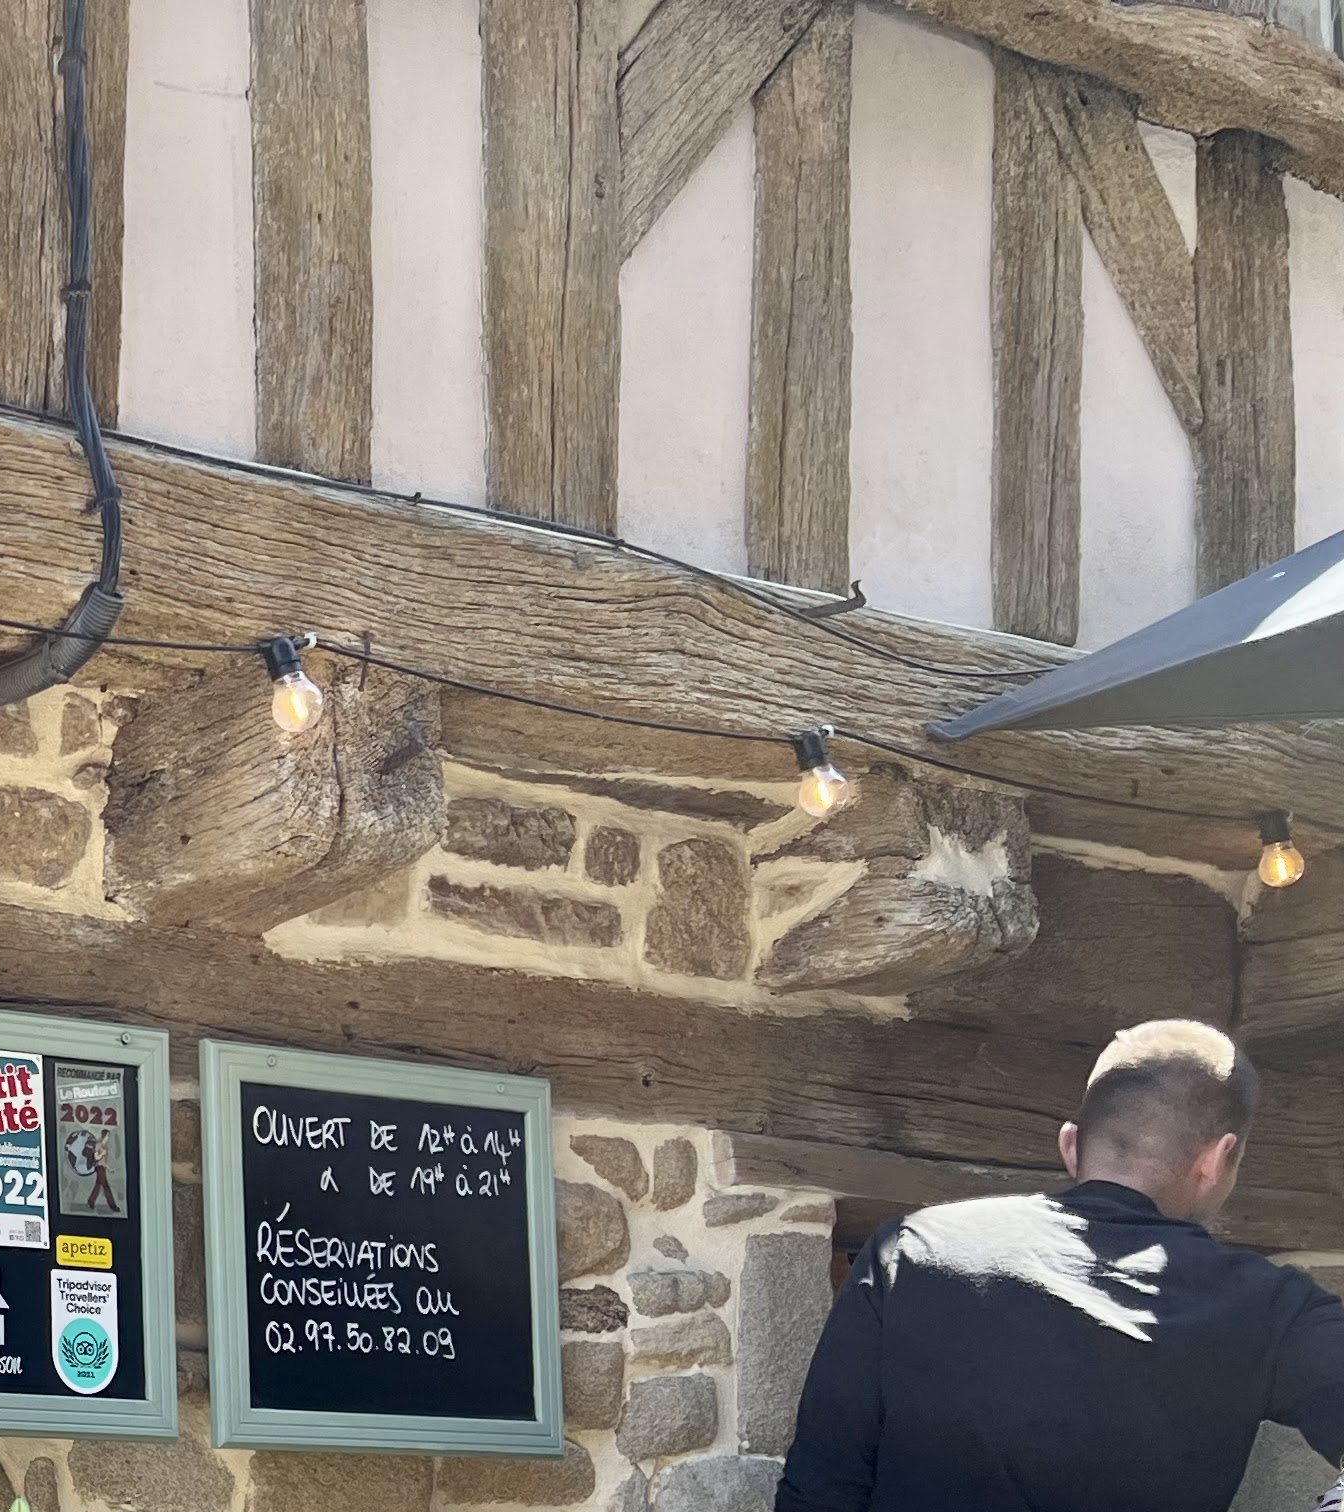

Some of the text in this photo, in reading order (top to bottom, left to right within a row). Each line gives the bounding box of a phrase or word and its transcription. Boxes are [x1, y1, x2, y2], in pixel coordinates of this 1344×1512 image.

[73, 1083, 118, 1099] Routard
[60, 1103, 118, 1126] 2022
[252, 1105, 352, 1150] OUVERT
[369, 1120, 399, 1151] DE
[460, 1125, 479, 1155] à
[368, 1165, 398, 1197] DE
[62, 1241, 107, 1257] apetiz
[56, 1278, 112, 1292] Tripadvisor
[66, 1302, 101, 1315] Choice
[265, 1319, 456, 1360] 02.97.50.82.09
